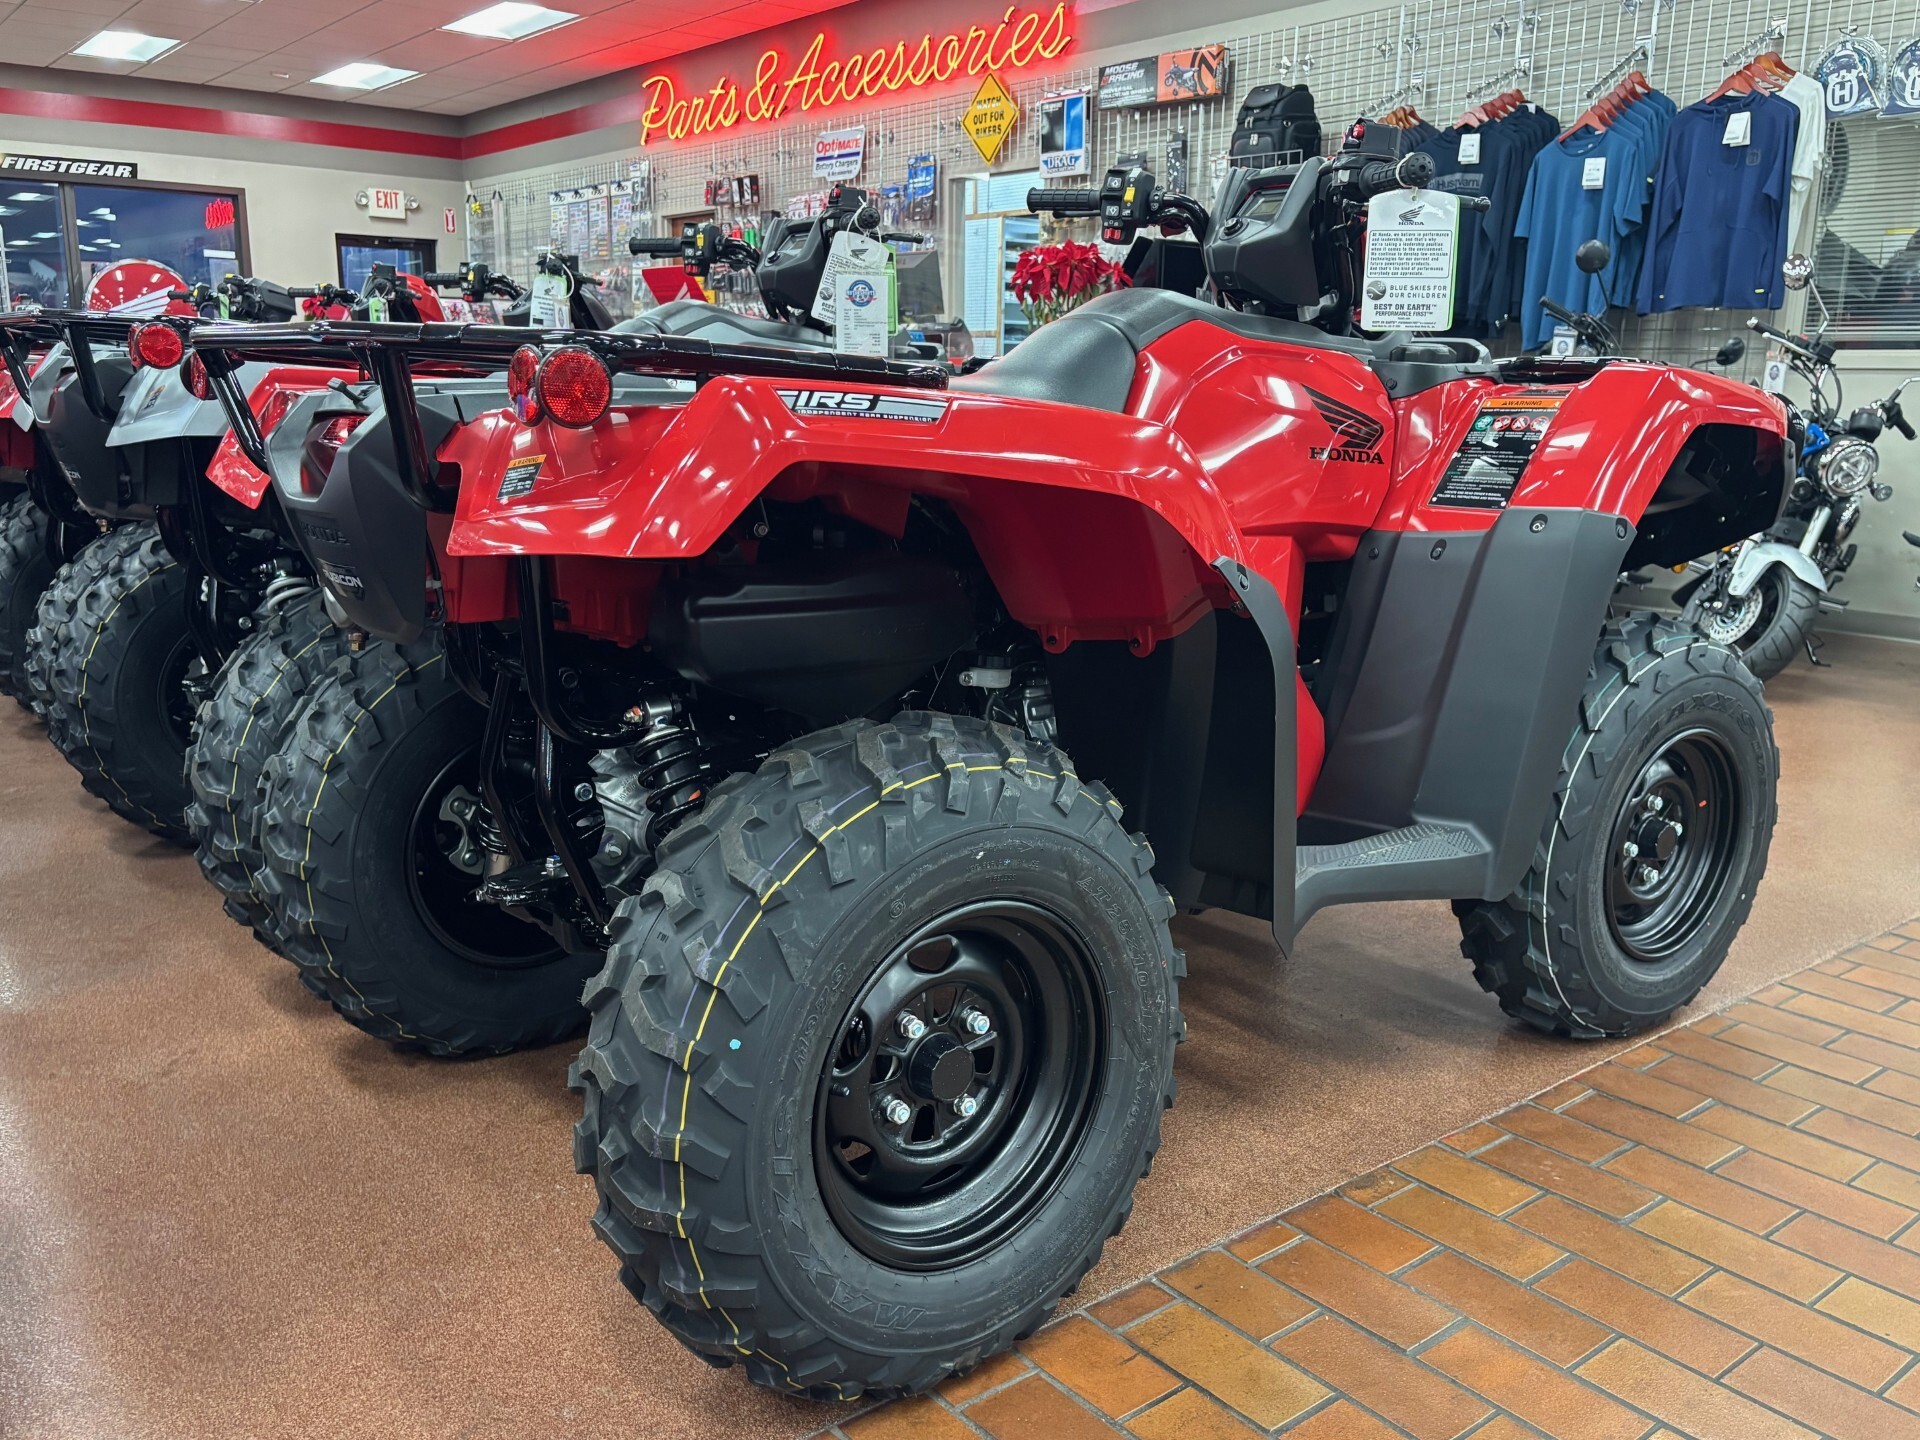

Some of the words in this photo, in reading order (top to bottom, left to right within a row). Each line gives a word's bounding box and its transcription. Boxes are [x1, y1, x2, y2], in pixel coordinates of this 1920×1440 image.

[640, 75, 741, 144] Parts
[746, 51, 780, 122] &
[775, 2, 1072, 117] Accessories
[1105, 62, 1139, 75] MOOSE
[1108, 68, 1145, 83] RACING
[973, 112, 988, 125] OUT
[989, 110, 1005, 121] FOR
[976, 125, 1002, 138] BIKERS
[816, 138, 860, 155] OptiMATE
[1, 156, 133, 178] FIRSTGEAR
[815, 161, 834, 171] Battery
[834, 159, 858, 169] Chargers
[1046, 153, 1075, 169] DRAG
[376, 190, 400, 210] EXIT
[796, 390, 874, 410] IRS
[797, 409, 858, 417] INDEPENDENT
[883, 414, 932, 422] SUSPENSION
[1309, 447, 1384, 464] HONDA
[771, 1095, 927, 1331] MAXXIS
